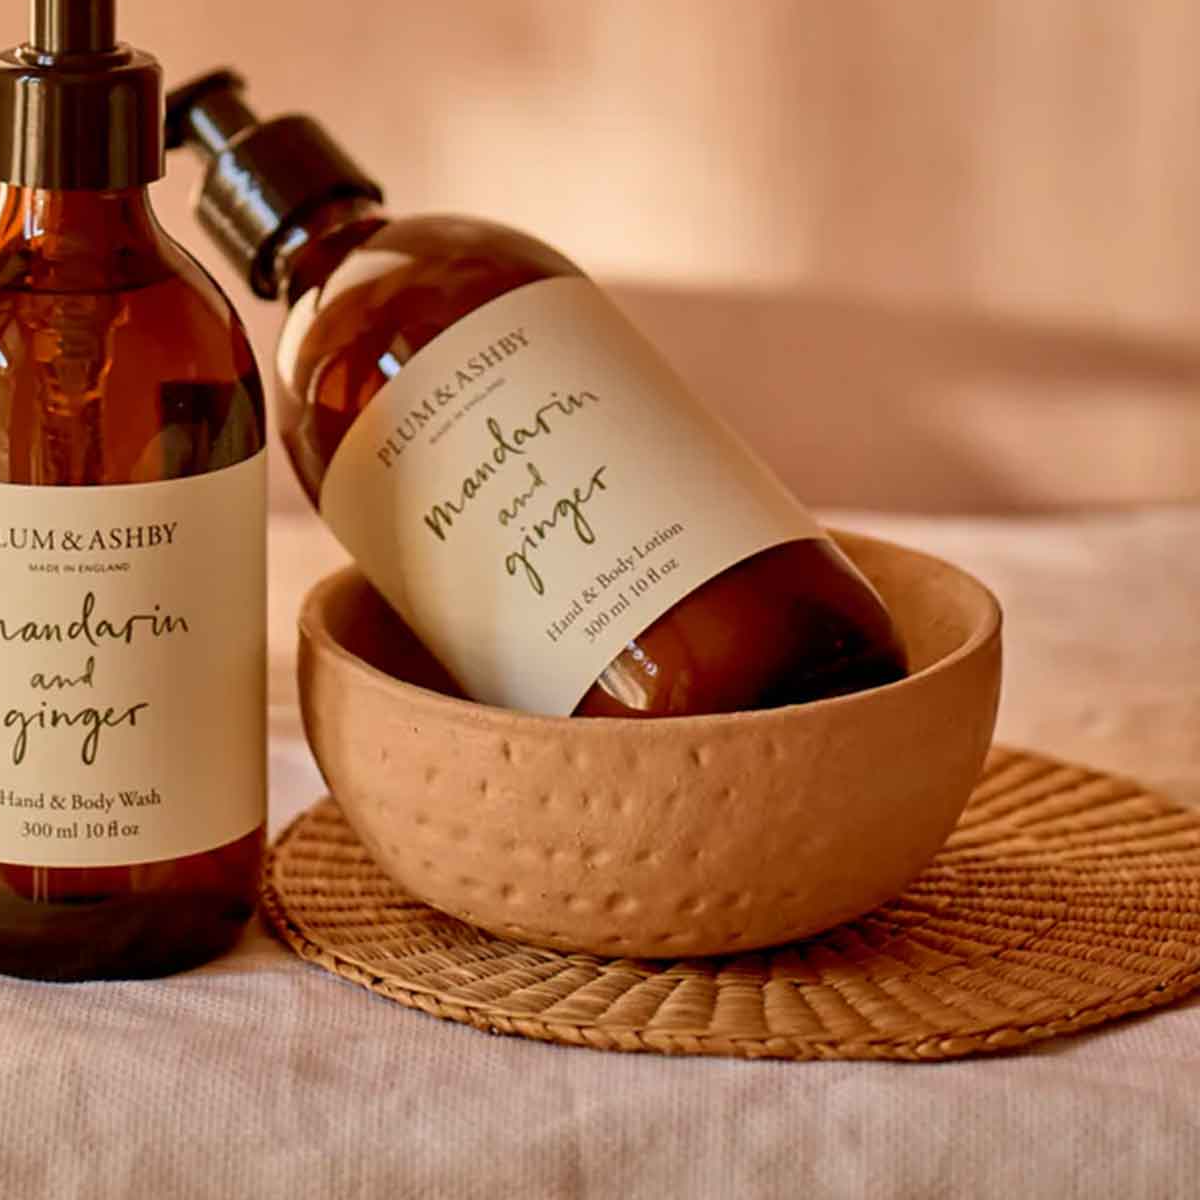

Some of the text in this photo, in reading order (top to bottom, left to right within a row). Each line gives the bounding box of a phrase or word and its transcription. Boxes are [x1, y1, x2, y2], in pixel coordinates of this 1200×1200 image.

[378, 399, 436, 468] PLUM
[434, 384, 456, 405] &
[455, 328, 529, 389] ASHBY
[498, 462, 547, 526] and
[61, 529, 84, 551] &
[88, 521, 178, 550] ASHBY
[505, 465, 607, 596] ginger
[546, 522, 684, 642] Hand & Body Lotion
[584, 612, 611, 643] 300
[610, 593, 631, 617] ml
[629, 578, 649, 598] 10
[660, 557, 680, 575] oz
[29, 655, 95, 690] and
[3, 701, 149, 765] ginger
[0, 789, 162, 815] Hand & Body Wash
[21, 820, 53, 837] 300
[56, 821, 79, 839] ml
[85, 822, 104, 839] 10
[120, 823, 140, 837] oz
